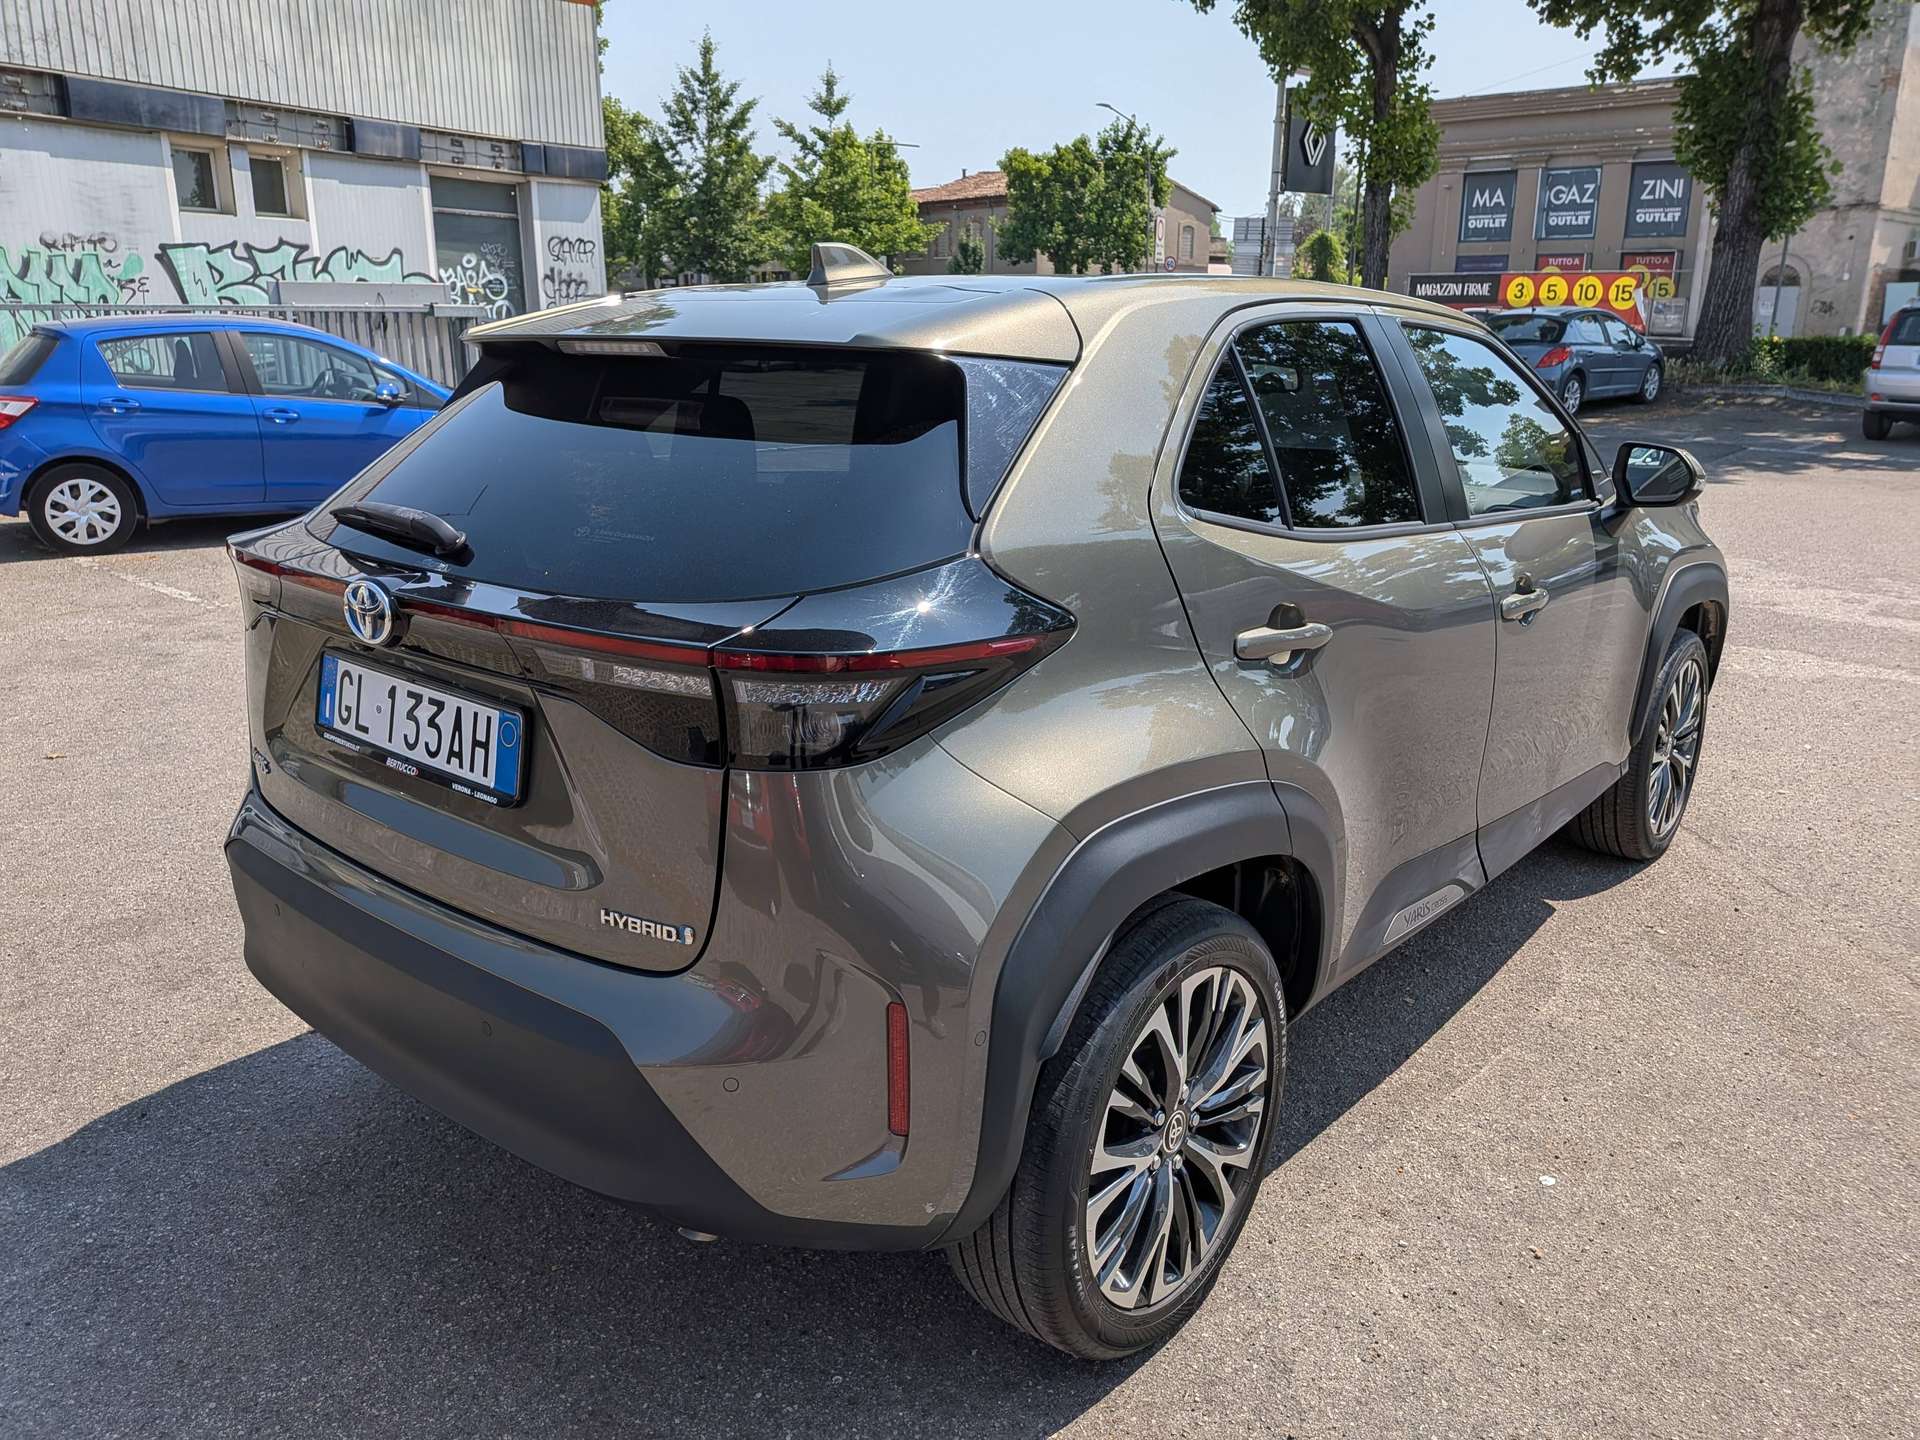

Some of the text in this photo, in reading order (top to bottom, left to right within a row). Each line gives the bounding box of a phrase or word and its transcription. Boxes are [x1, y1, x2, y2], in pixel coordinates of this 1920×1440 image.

[1472, 186, 1506, 208] MA
[1549, 183, 1597, 206] GAZ
[1640, 178, 1685, 201] ZINI
[1468, 218, 1507, 229] OUTLET
[1549, 215, 1591, 226] OUTLET
[1636, 212, 1681, 223] OUTLET
[1548, 257, 1580, 266] TUTTO A
[1635, 256, 1670, 265] TUTTO A
[1415, 282, 1492, 297] MAGAZZINI FIRME
[337, 669, 492, 778] GL 133AH
[385, 756, 416, 776] BERTUCCO
[451, 782, 471, 797] VERONA
[1403, 901, 1431, 928] YARIS
[600, 908, 677, 943] HYBRID
[1274, 981, 1287, 1068] GOODYEAR
